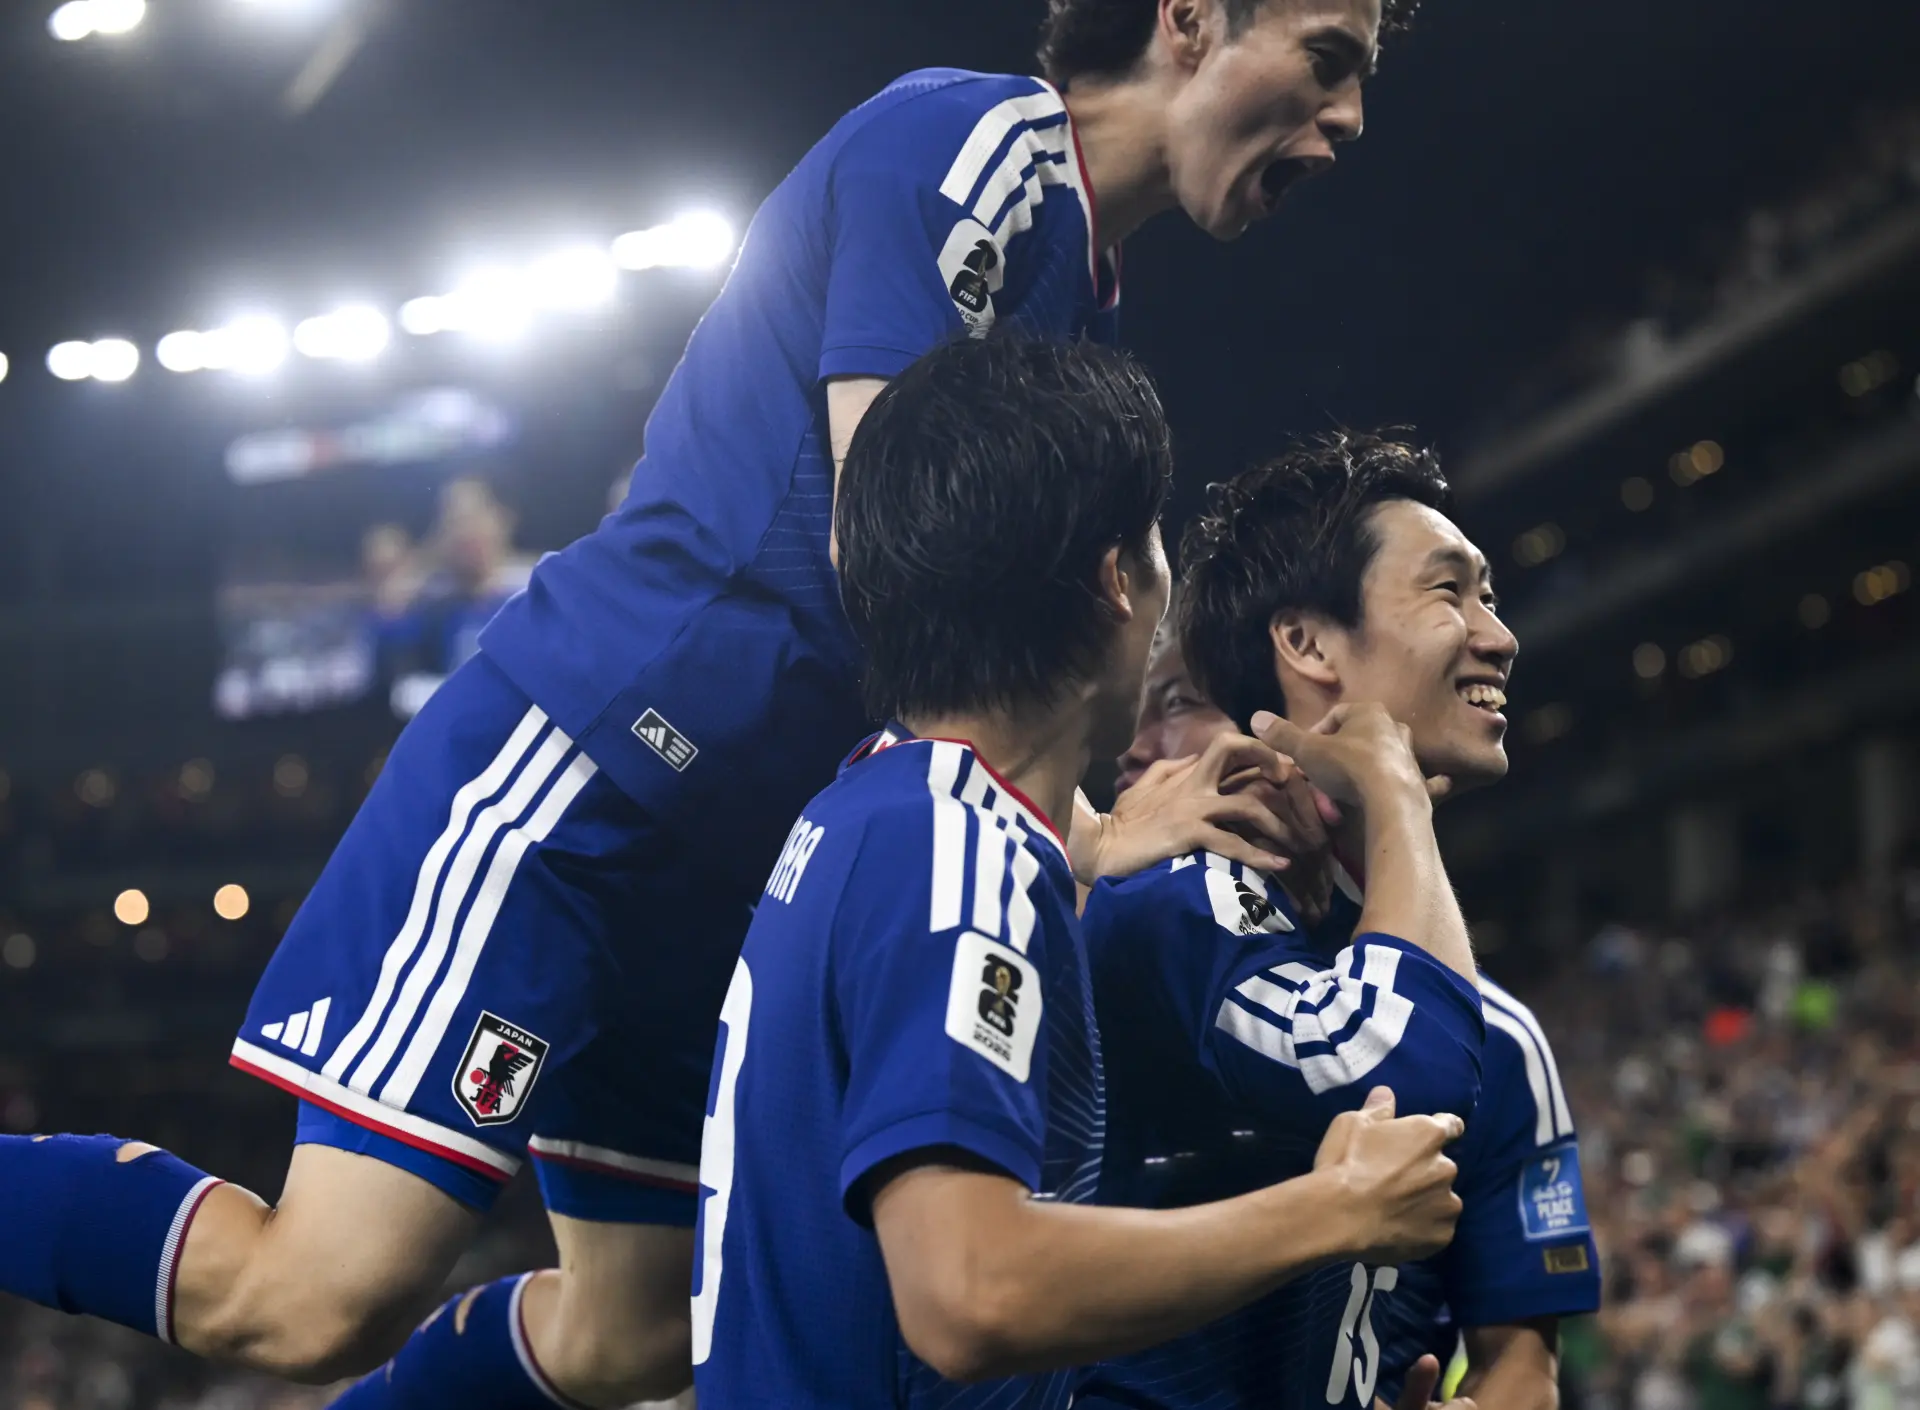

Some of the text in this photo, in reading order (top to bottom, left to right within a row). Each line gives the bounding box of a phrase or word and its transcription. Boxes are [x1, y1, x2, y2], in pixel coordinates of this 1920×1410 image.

[958, 289, 978, 306] FIFA
[497, 1024, 533, 1047] JAPAN
[469, 1087, 501, 1113] JFA
[1326, 1262, 1398, 1409] 15
